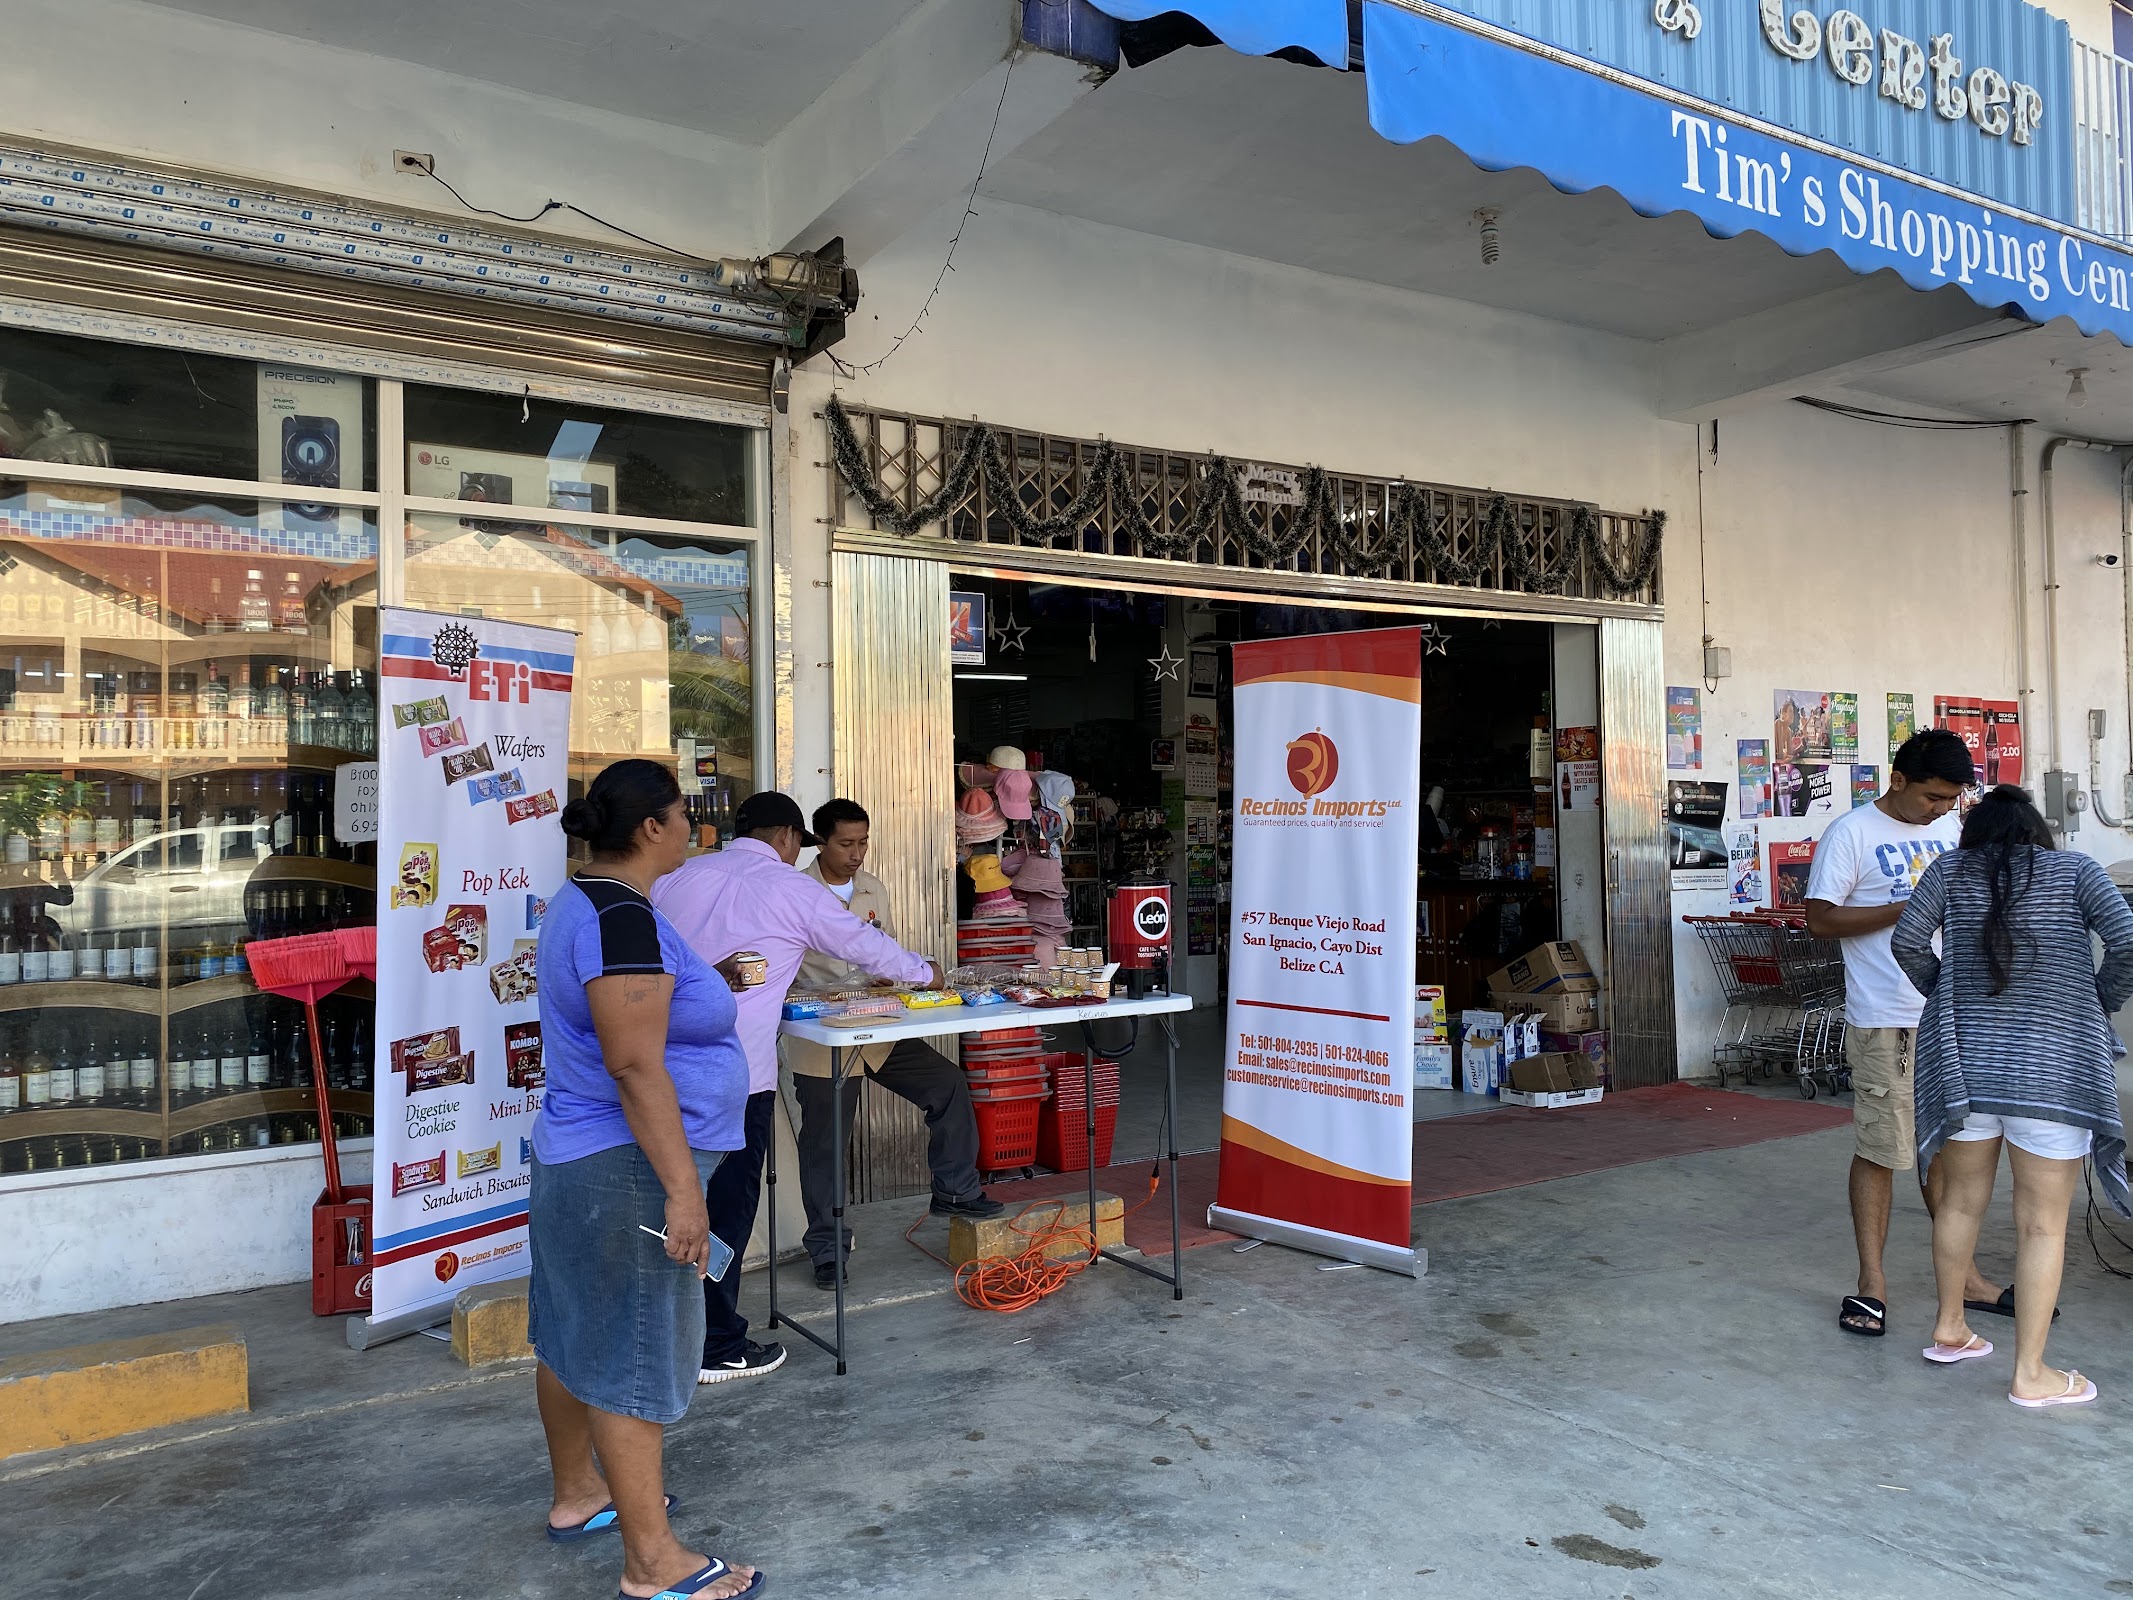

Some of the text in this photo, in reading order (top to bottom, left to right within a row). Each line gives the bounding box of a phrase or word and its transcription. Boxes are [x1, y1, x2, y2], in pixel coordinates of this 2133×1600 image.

[1671, 110, 2133, 313] Tim's Shopping Cen
[265, 371, 336, 384] PRECISION
[434, 454, 450, 466] LG
[1245, 461, 1297, 489] Merry
[246, 608, 266, 617] 1800
[285, 611, 304, 619] 1800
[1887, 702, 1913, 710] MULTIPLY
[494, 734, 545, 761] Wafers
[1809, 775, 1825, 789] MORE
[1240, 798, 1307, 817] Recinos
[1312, 798, 1387, 820] Imports
[1243, 817, 1384, 829] Guaranteed prices, quality and service!
[1731, 849, 1759, 861] BELIKIN
[461, 867, 530, 896] Pop Kek
[1140, 910, 1166, 925] León
[1240, 911, 1386, 933] #57 Benque Viejo Road
[1242, 932, 1383, 956] San Ignacio, Cayo Dist
[1279, 956, 1345, 975] Belize C.A
[510, 1037, 540, 1050] KOMBO
[1240, 1033, 1257, 1048] Tel:
[1258, 1035, 1319, 1058] 501-804-2935
[1325, 1044, 1389, 1067] 501-824-4066
[415, 1067, 448, 1079] Digestive
[1238, 1050, 1391, 1087] Email: sales@recinosimports.com
[1469, 1059, 1479, 1088] Ensure
[1226, 1068, 1404, 1108] customerservice@recinosimports.com
[405, 1100, 460, 1123] Digestive
[489, 1100, 521, 1121] Mini
[408, 1118, 457, 1139] Cookies
[422, 1173, 531, 1213] Sandwich Biscuits
[461, 1250, 492, 1266] Recinos
[493, 1241, 523, 1256] Imports
